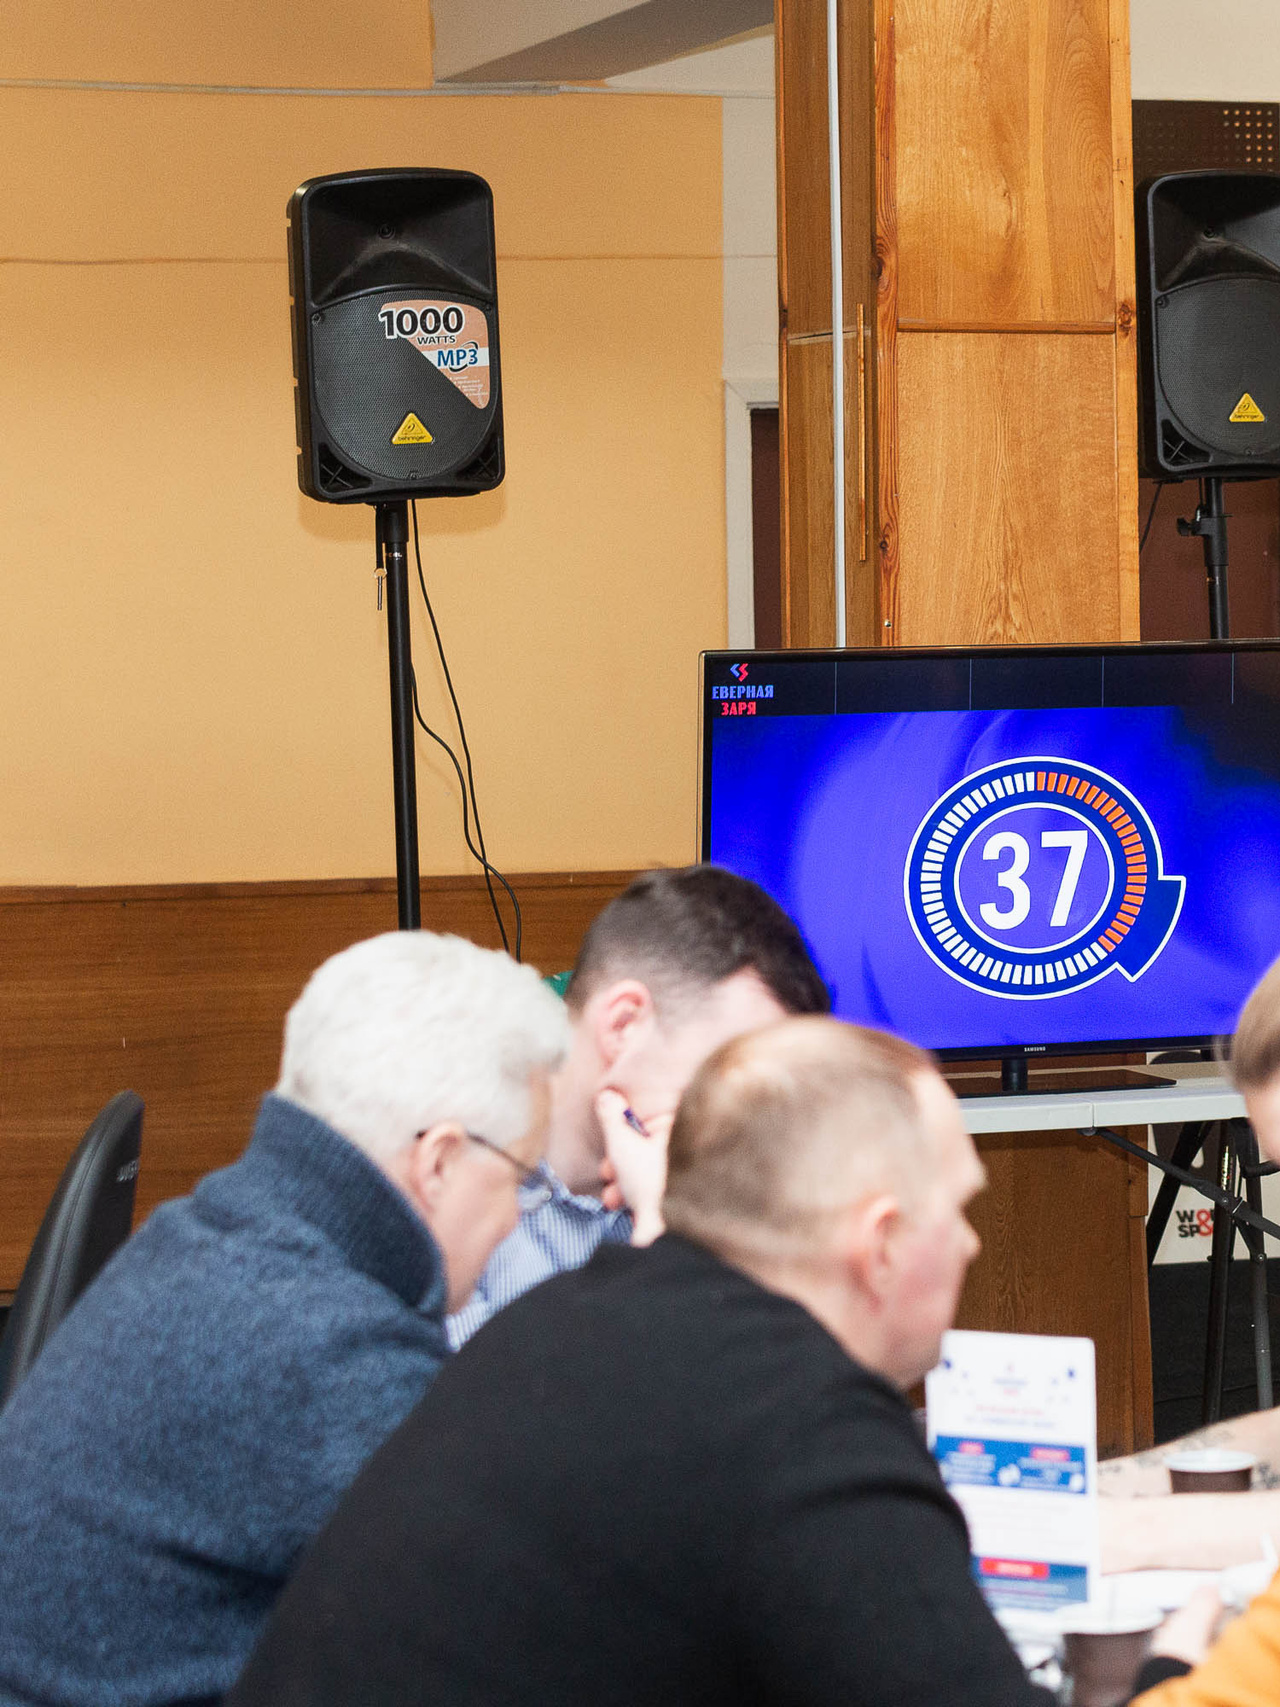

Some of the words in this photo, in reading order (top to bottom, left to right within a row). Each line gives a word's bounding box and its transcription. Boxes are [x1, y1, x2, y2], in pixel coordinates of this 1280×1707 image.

[379, 306, 464, 338] 1000
[417, 334, 456, 345] WATTS
[437, 348, 478, 367] MP3
[712, 685, 774, 699] ЕВЕРНАЯ
[721, 701, 757, 715] ЗАРЯ
[978, 830, 1089, 930] 37
